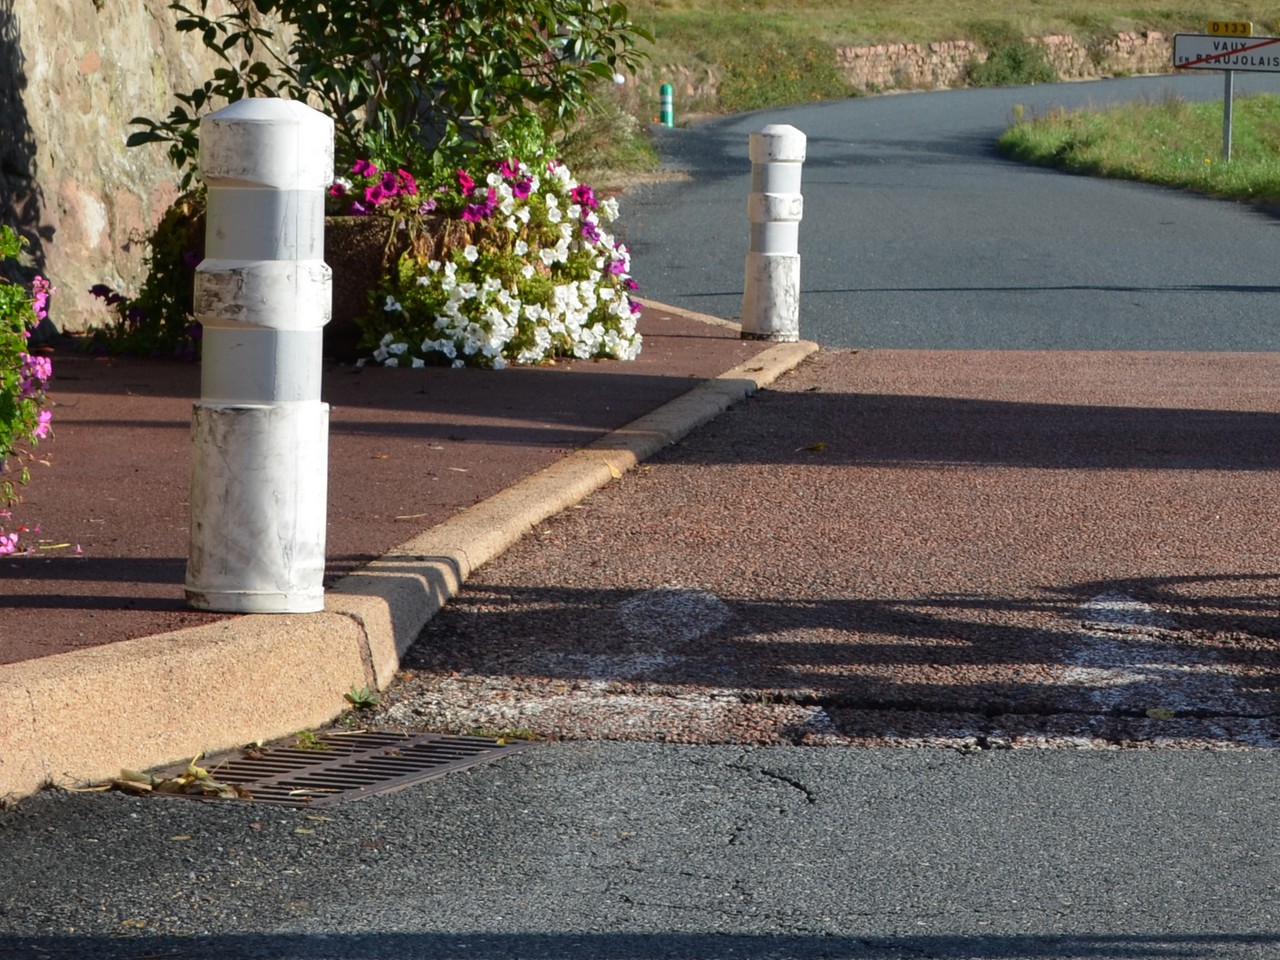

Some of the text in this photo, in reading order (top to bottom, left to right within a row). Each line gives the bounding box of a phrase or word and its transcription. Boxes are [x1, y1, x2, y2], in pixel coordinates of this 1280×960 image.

[1213, 22, 1247, 34] D 133
[1213, 41, 1247, 52] VAUX
